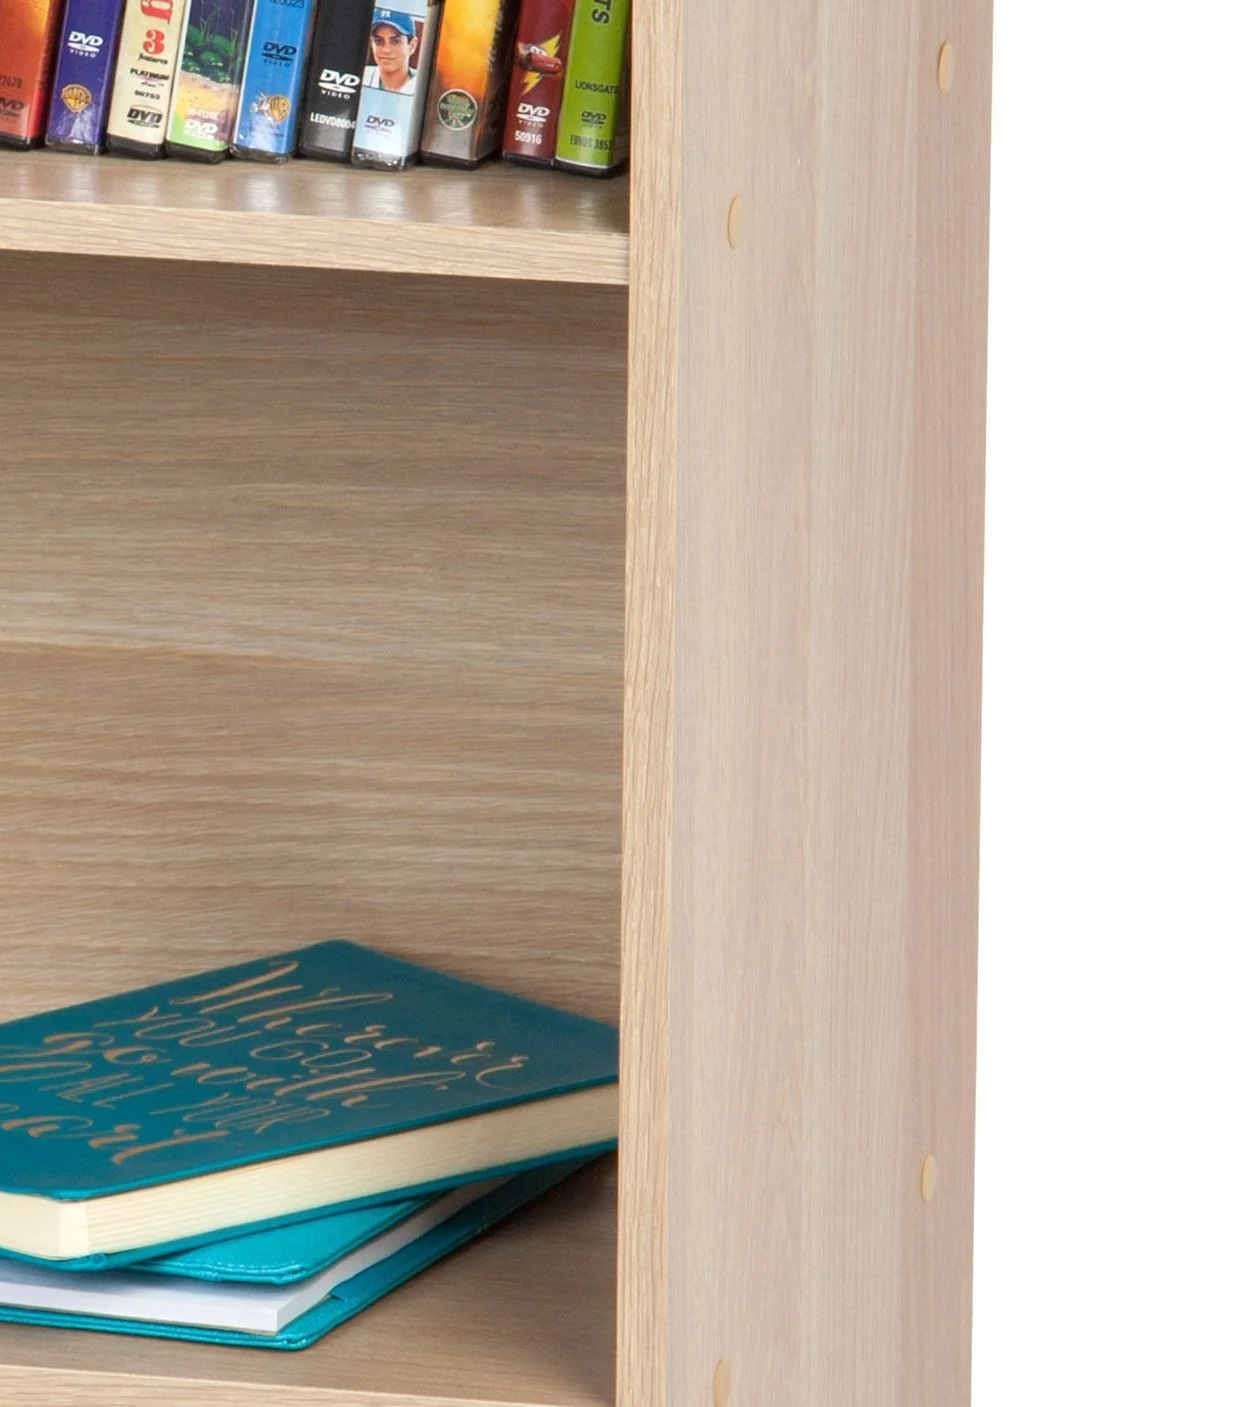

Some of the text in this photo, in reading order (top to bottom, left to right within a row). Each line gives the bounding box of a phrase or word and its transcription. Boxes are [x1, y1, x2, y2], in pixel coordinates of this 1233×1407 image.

[69, 31, 103, 47] DVD
[143, 29, 165, 55] 3
[69, 49, 97, 59] VIDEO
[263, 42, 297, 57] DVD
[130, 68, 170, 81] PLATINUM
[320, 69, 361, 87] DVD
[321, 89, 350, 100] VIDEO
[575, 80, 619, 94] LIONSGATE
[127, 108, 163, 124] DVD
[517, 102, 551, 117] DVD
[184, 119, 219, 135] DVD
[366, 115, 395, 128] DVD
[514, 129, 543, 145] 50916
